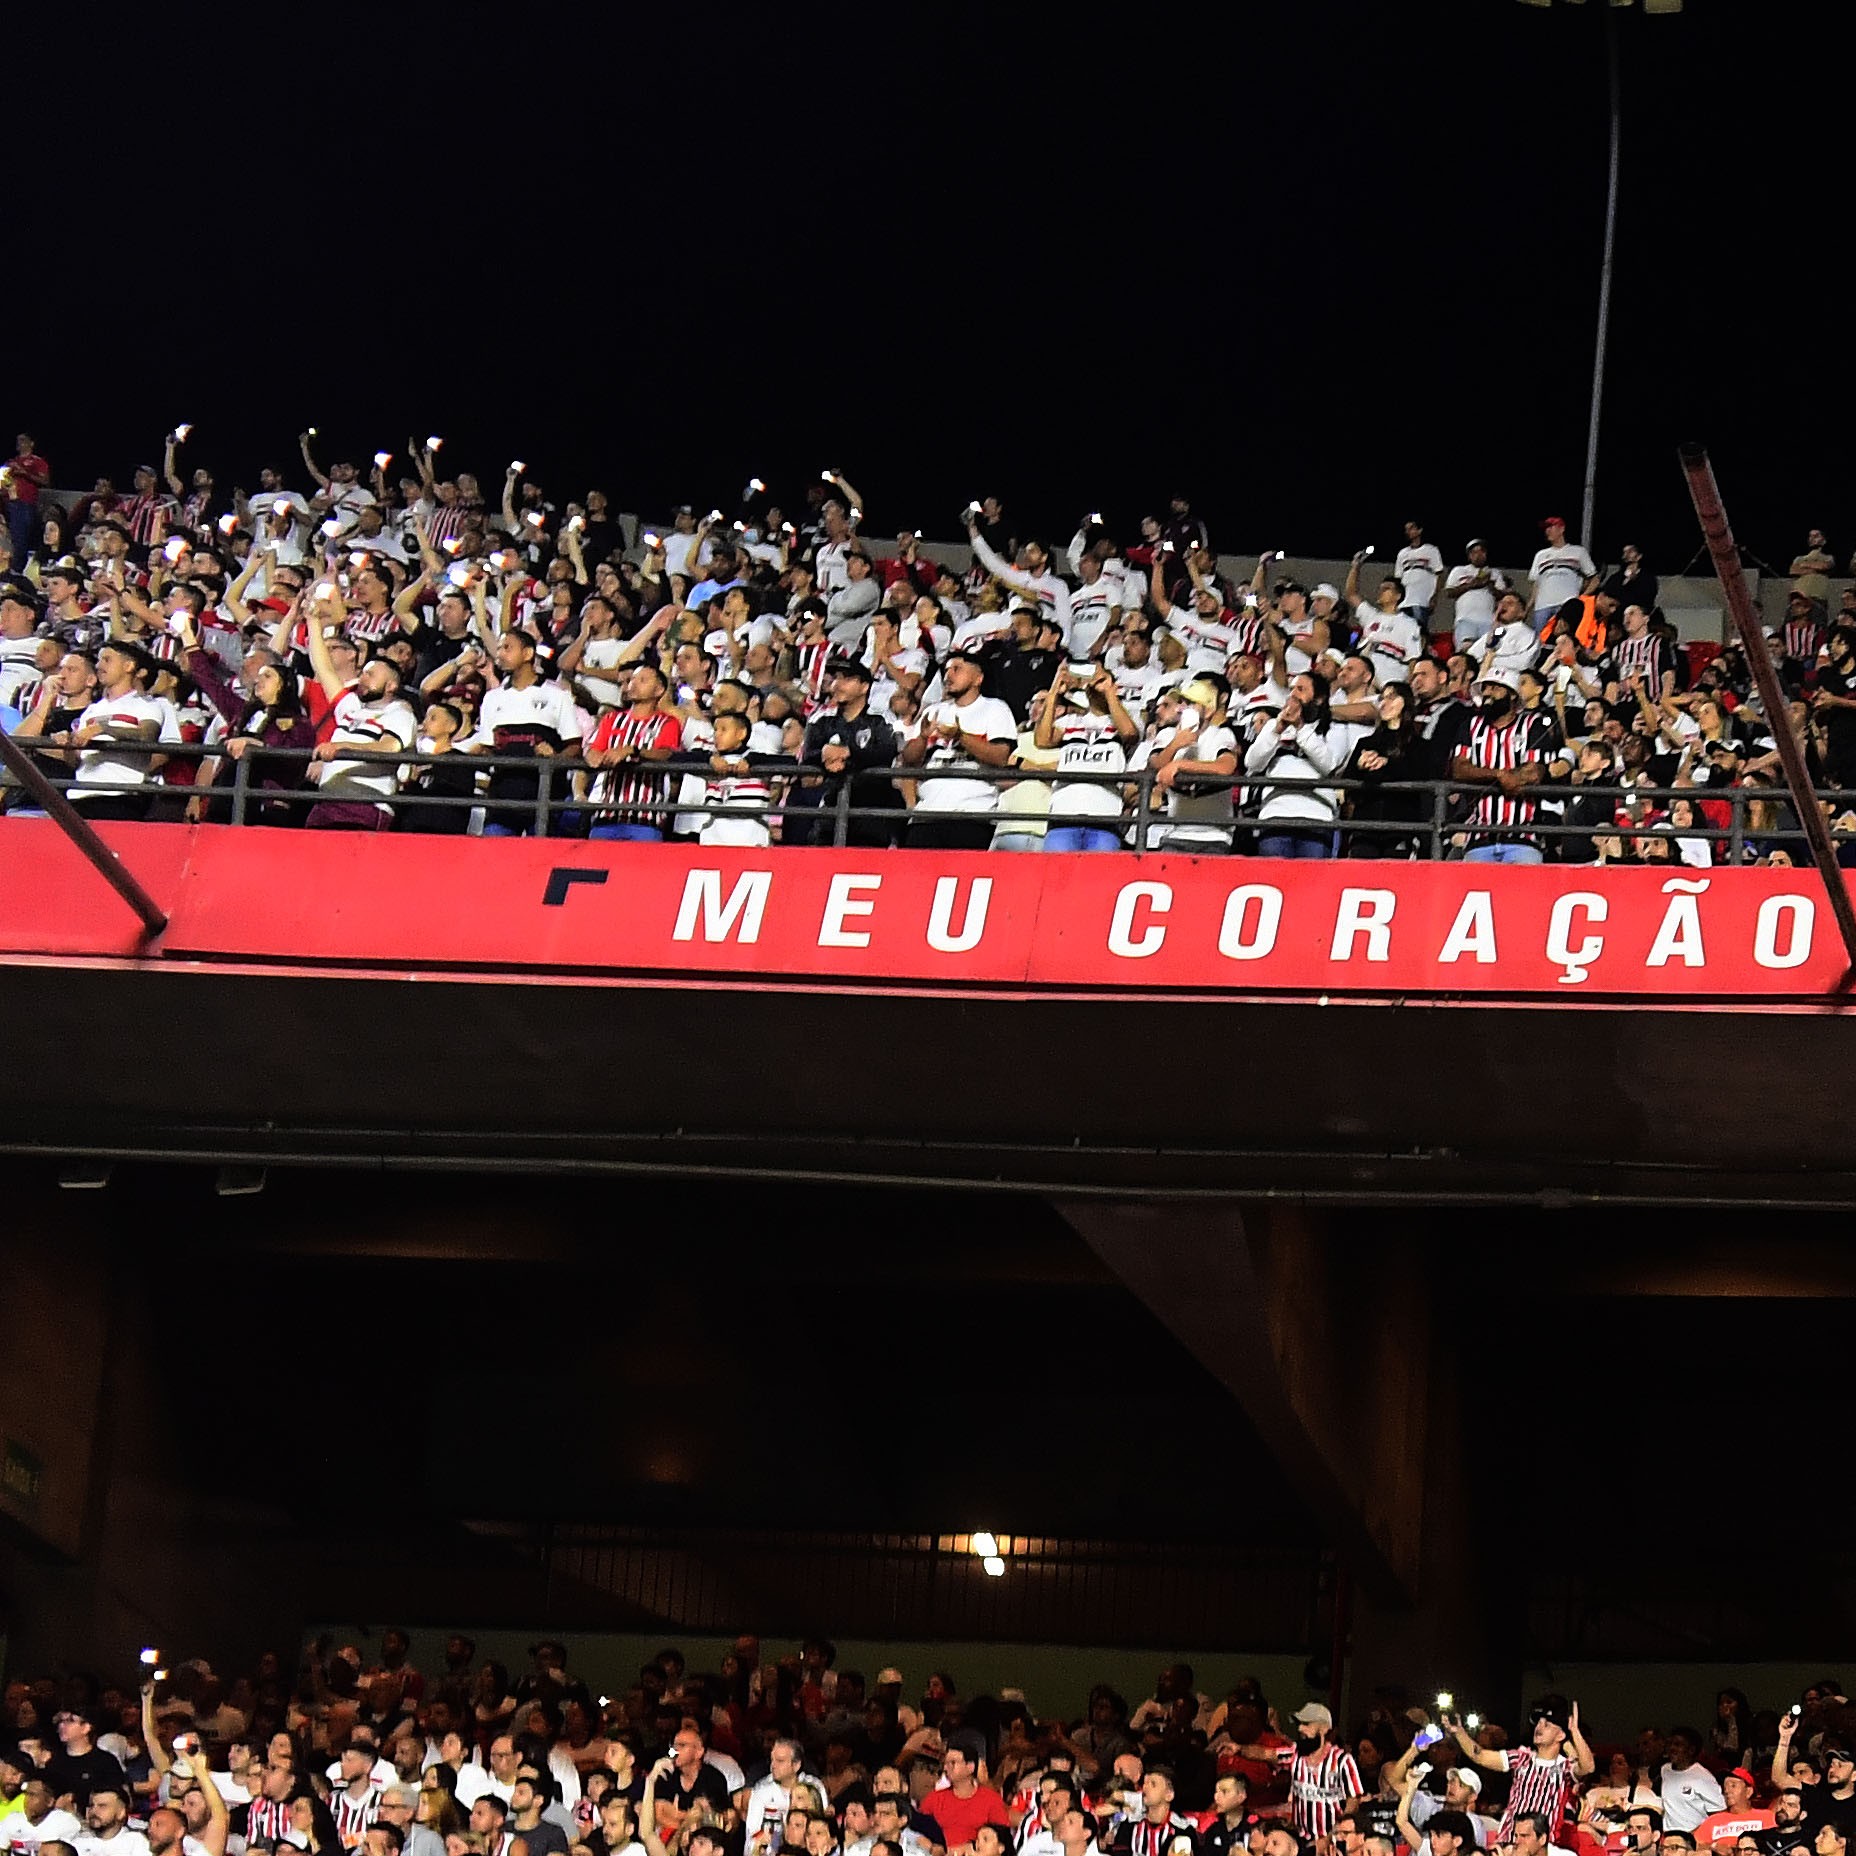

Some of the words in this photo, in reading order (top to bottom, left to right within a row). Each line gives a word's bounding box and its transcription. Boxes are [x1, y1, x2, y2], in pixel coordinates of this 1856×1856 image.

[1064, 748, 1113, 765] inter
[672, 867, 994, 954] MEU
[1106, 876, 1816, 985] CORAÇÃO
